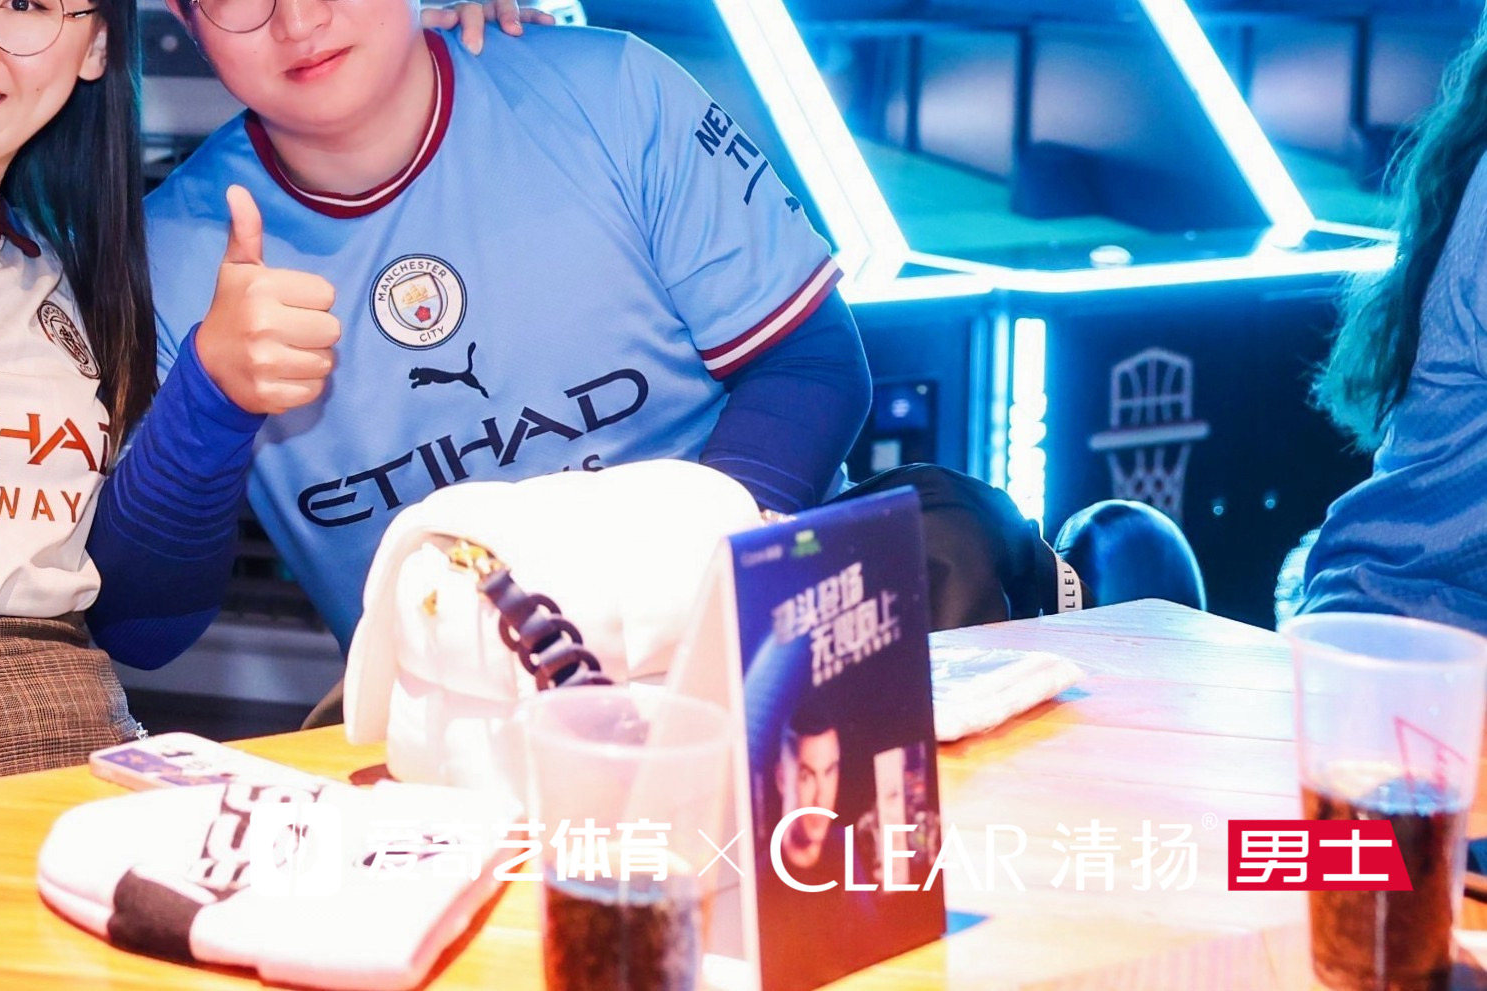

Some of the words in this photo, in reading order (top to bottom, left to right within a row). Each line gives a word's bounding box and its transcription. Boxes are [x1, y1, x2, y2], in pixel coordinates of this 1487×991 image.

[378, 261, 447, 301] MANCHESTER
[419, 326, 444, 342] CITY
[298, 368, 649, 528] ETIHAD
